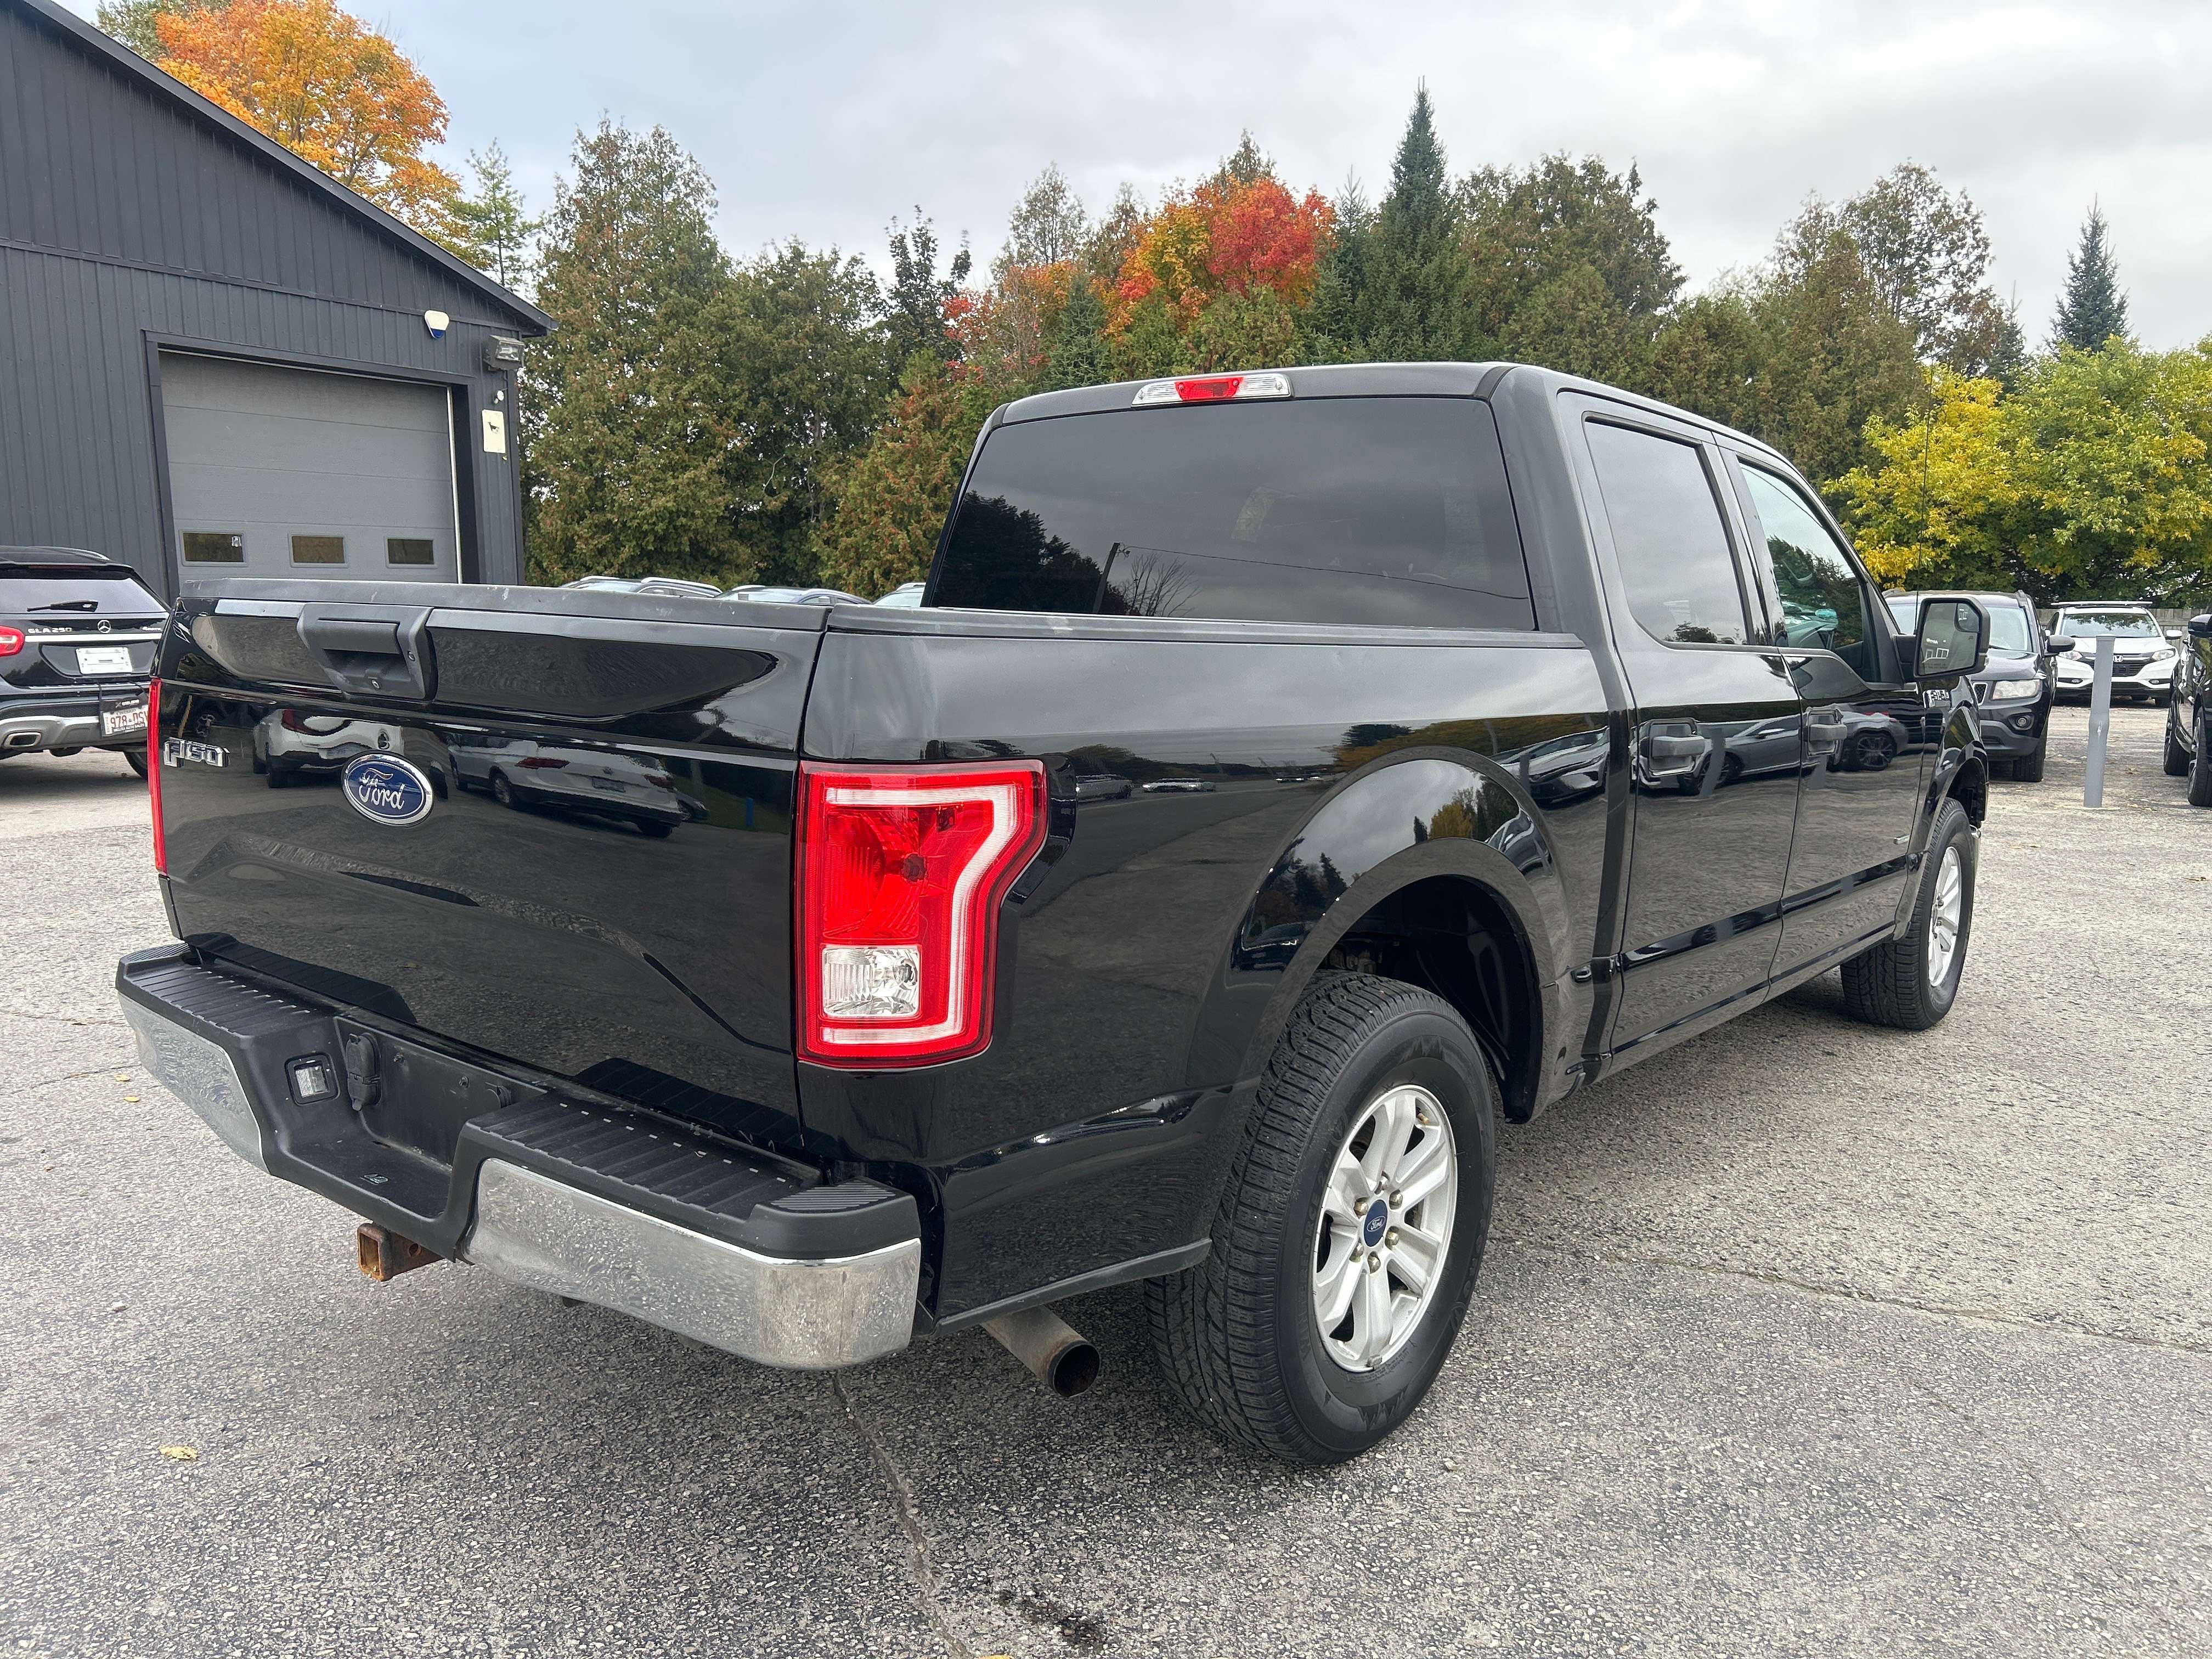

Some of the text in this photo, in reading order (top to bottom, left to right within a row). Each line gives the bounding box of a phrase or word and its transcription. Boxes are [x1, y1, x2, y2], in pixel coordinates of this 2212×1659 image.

[110, 715, 127, 728] 978
[358, 768, 405, 810] Ford
[1370, 1217, 1383, 1230] Ford
